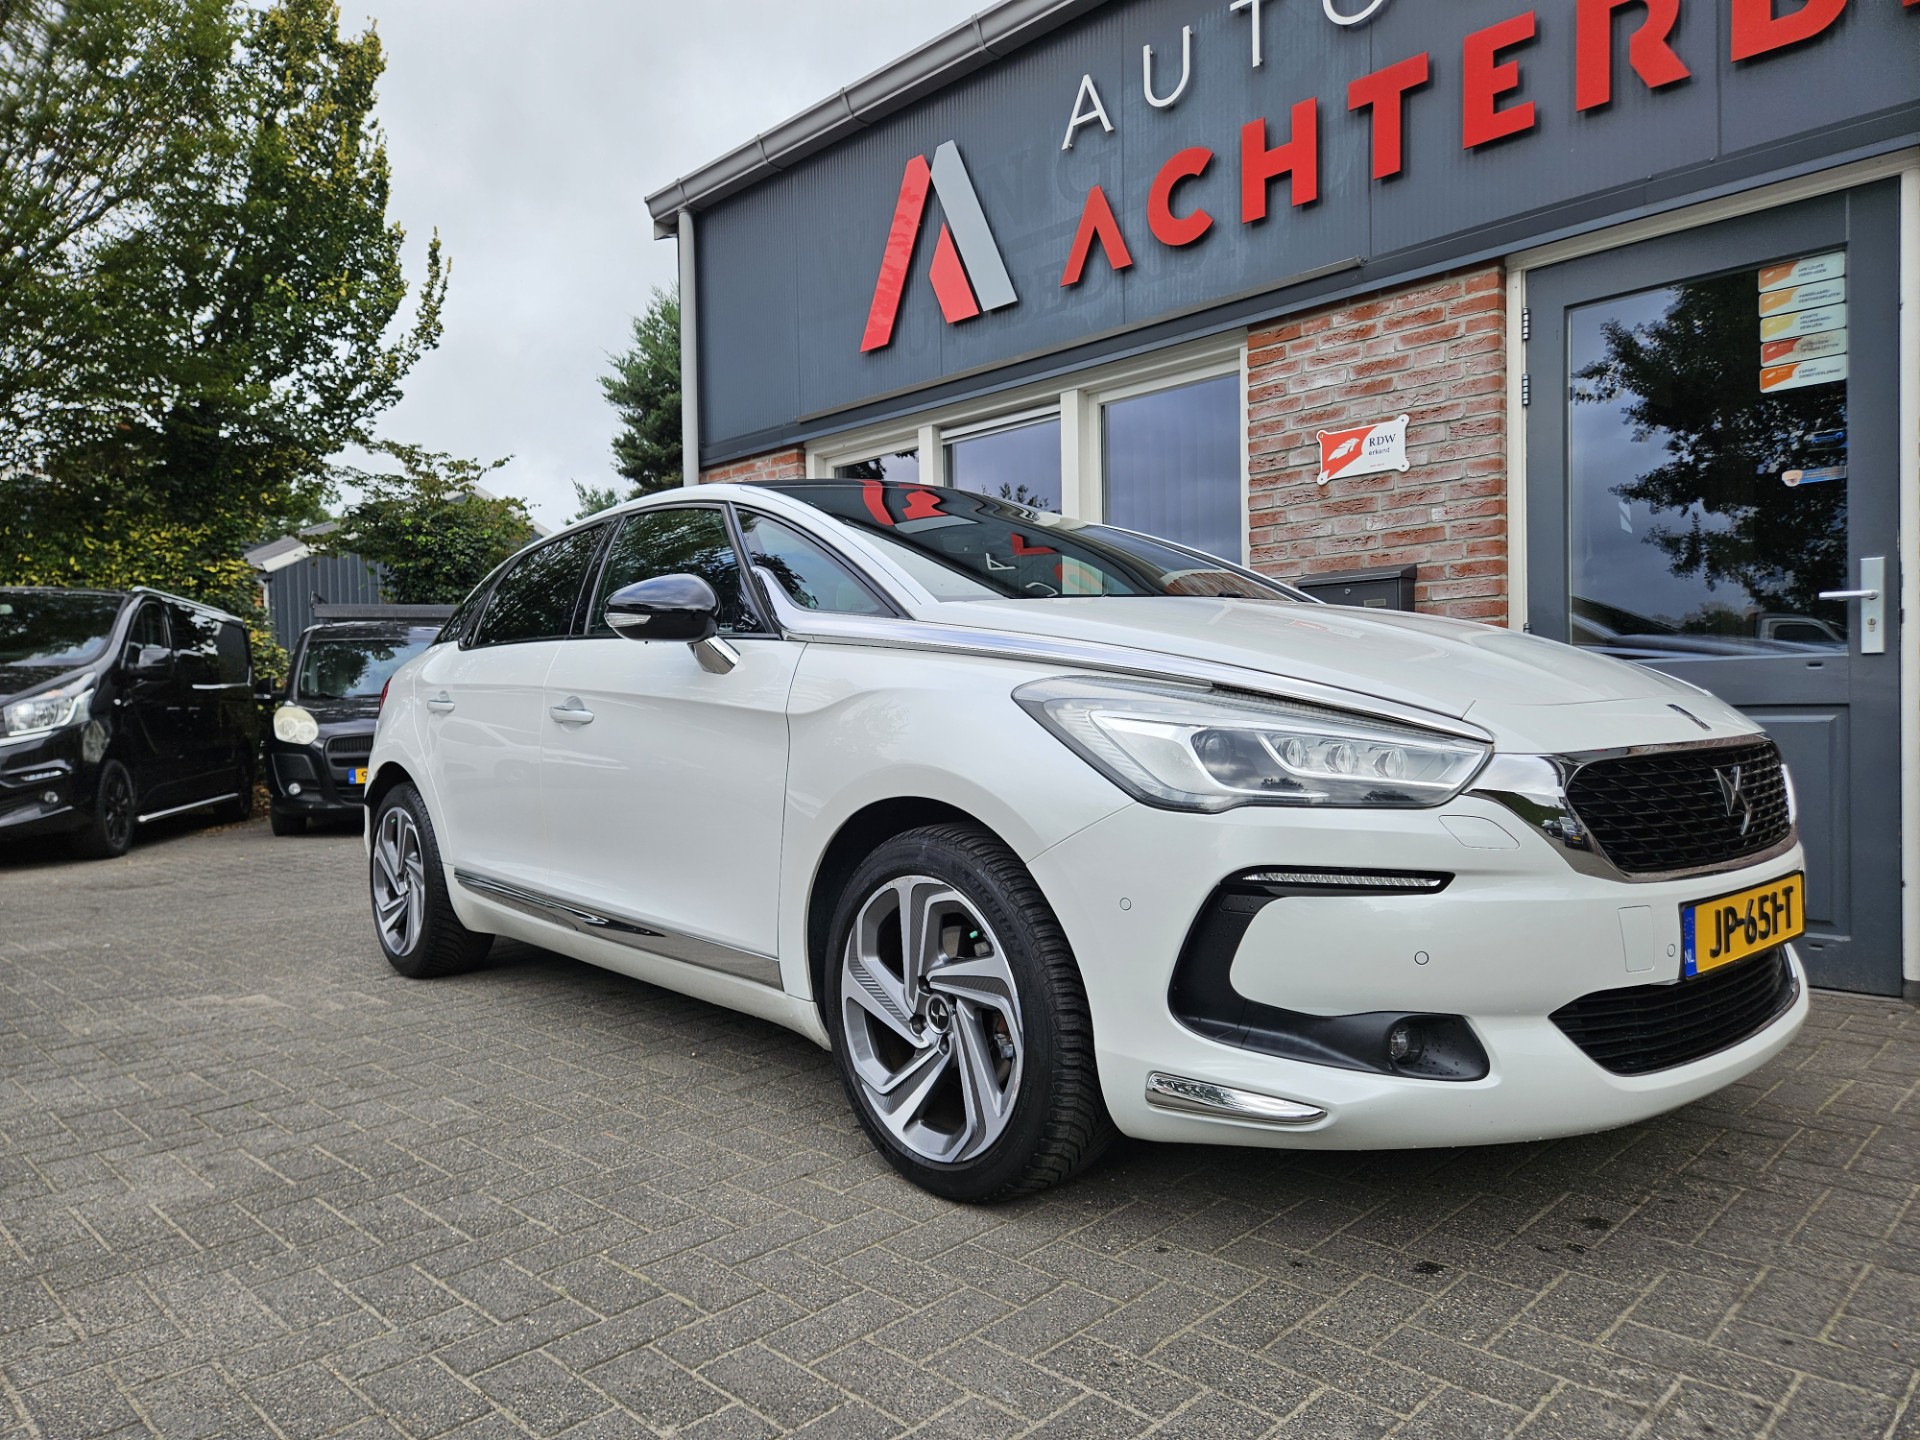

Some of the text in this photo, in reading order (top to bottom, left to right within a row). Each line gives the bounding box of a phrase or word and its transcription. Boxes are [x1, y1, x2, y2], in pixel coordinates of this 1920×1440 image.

[1061, 0, 1384, 151] AUT
[1060, 0, 1920, 287] ACHTER
[1368, 433, 1397, 447] RDW
[1709, 885, 1794, 959] JP-651-T
